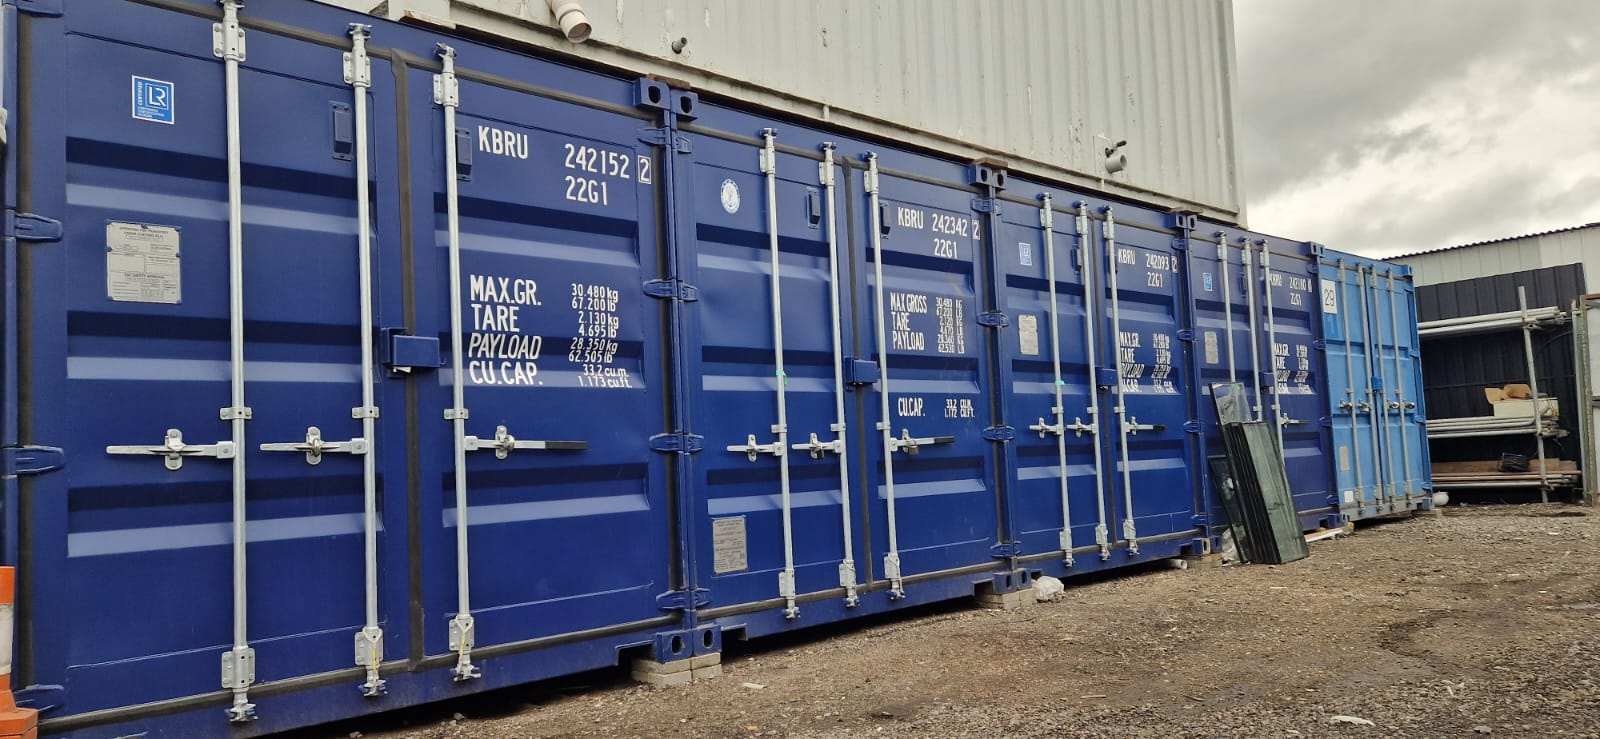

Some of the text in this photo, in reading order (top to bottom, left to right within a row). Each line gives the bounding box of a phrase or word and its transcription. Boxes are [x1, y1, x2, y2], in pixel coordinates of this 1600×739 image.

[149, 86, 166, 107] LR
[478, 125, 651, 184] KBRU 242152 2
[564, 175, 608, 205] 22G1
[897, 206, 980, 240] KBRU 242342 2
[933, 238, 958, 259] 22G1
[1117, 248, 1136, 265] KBRU
[1145, 253, 1170, 271] 242093
[1147, 271, 1163, 288] 22G1
[469, 274, 542, 306] MAX.GR.
[571, 283, 619, 303] 30.480 kg
[1323, 288, 1335, 307] 29
[571, 296, 616, 312] 67.200 lb
[906, 293, 928, 314] GROSS
[471, 304, 520, 332] TARE
[578, 310, 619, 329] 2.130 kg
[891, 312, 911, 331] TARE
[578, 323, 617, 338] 4.695 lb
[468, 332, 542, 360] PAYLOAD
[570, 337, 619, 355] 28.350 kg
[892, 331, 925, 351] PAYLOAD
[568, 350, 613, 364] 62.505 lb
[1120, 347, 1135, 363] TARE
[468, 360, 543, 385] CU.CAP.
[898, 397, 926, 417] CU.CAP.
